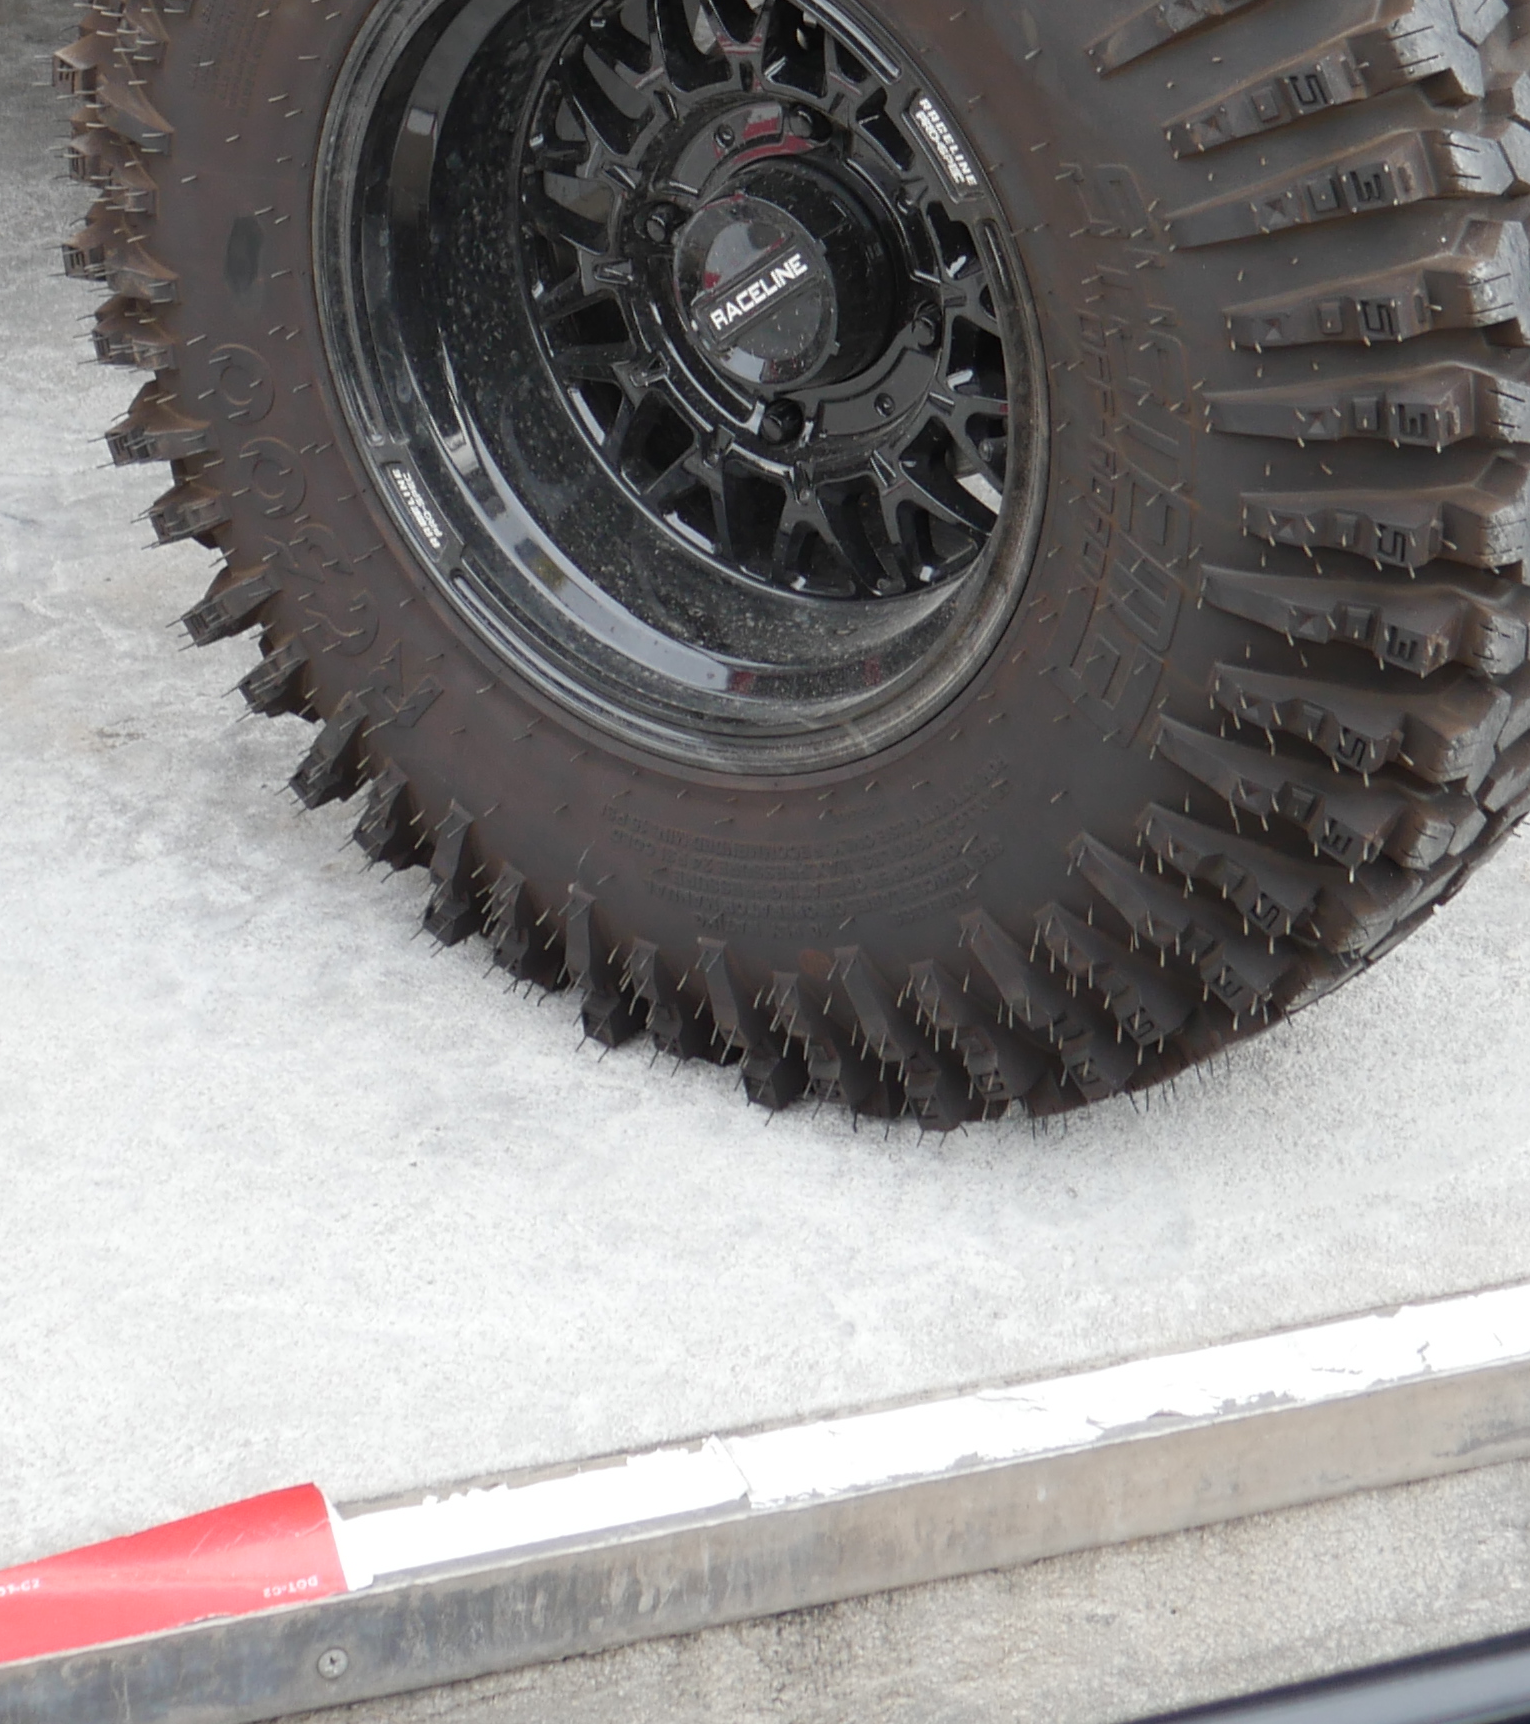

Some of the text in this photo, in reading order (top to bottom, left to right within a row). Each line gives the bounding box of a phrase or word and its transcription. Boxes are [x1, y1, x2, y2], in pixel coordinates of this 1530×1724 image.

[918, 97, 978, 188] RACELINE
[709, 254, 809, 331] RACELINE
[263, 1575, 317, 1599] DOT-C2
